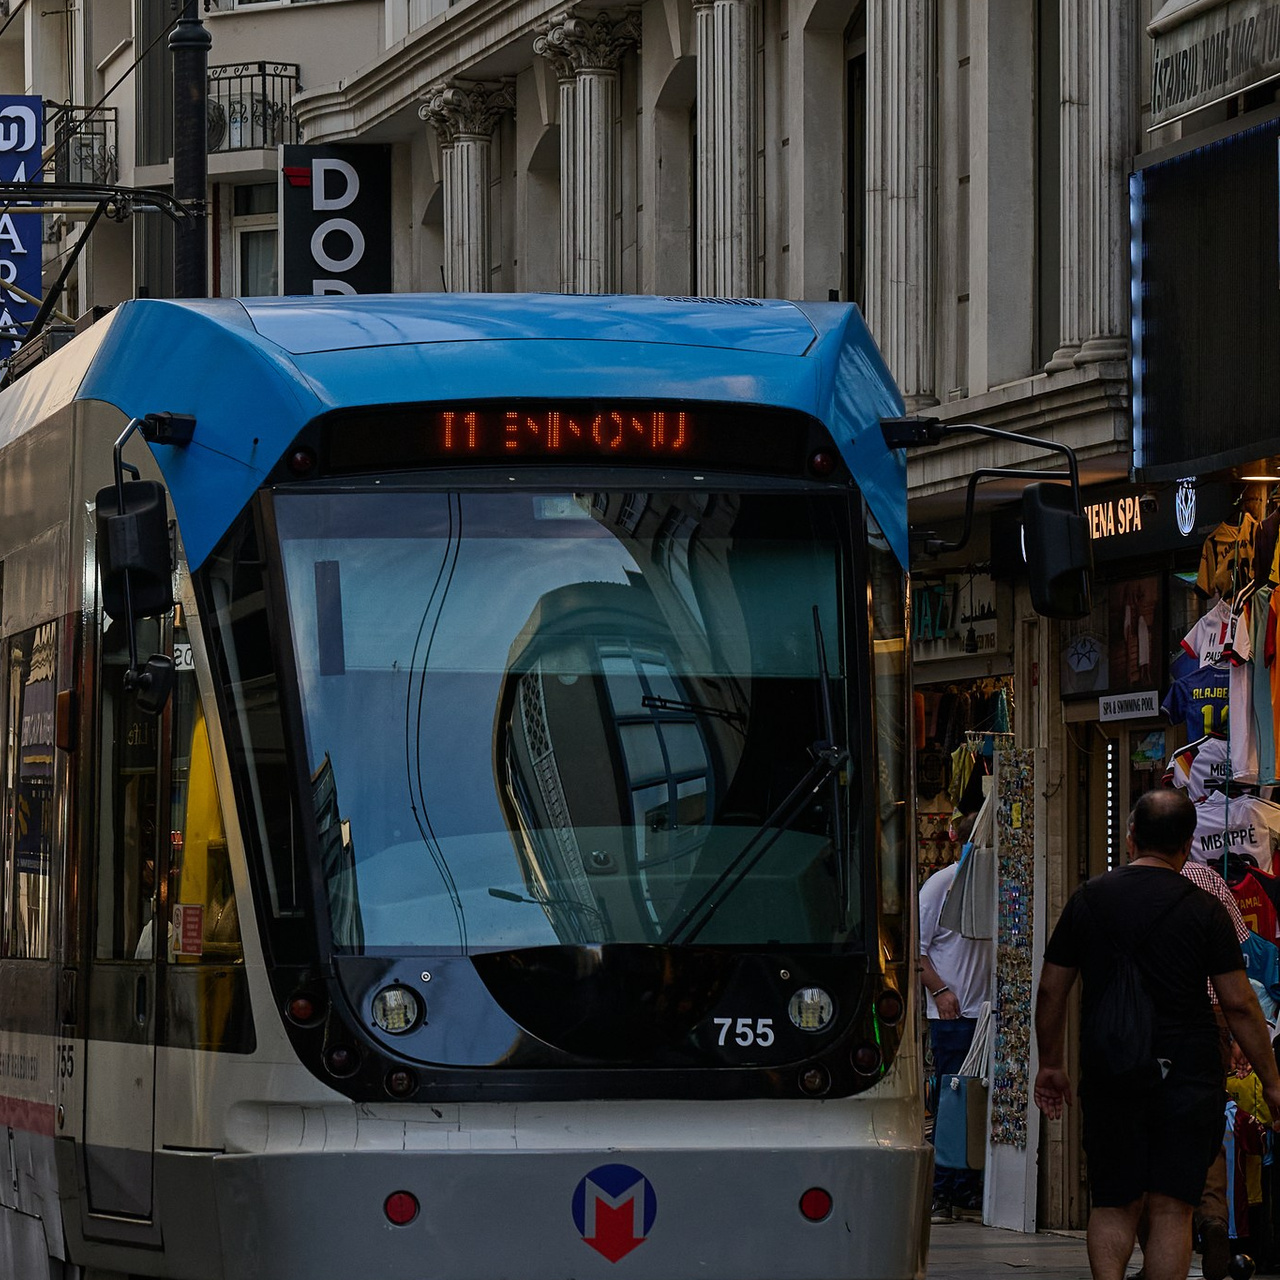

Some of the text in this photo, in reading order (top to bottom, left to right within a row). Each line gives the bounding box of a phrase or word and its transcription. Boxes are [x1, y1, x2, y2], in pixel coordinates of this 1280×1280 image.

[1118, 495, 1142, 535] SPA
[1192, 686, 1229, 700] ALAJBE
[1200, 824, 1258, 851] MBAPPÉ
[713, 1017, 775, 1047] 755
